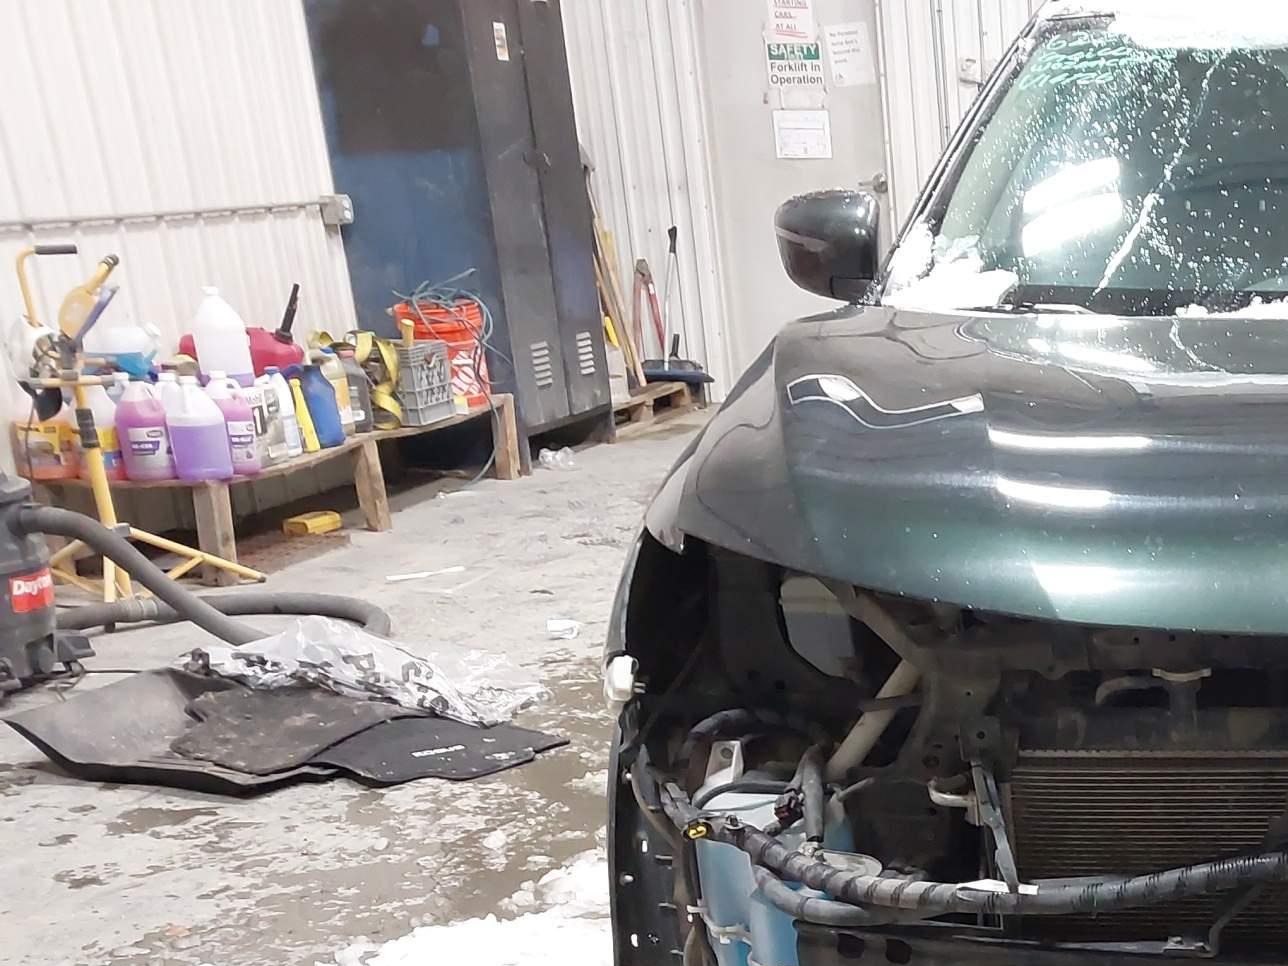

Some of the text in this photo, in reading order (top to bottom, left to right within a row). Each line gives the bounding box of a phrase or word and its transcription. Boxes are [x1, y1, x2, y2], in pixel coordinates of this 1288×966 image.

[769, 44, 817, 56] SAFETY
[770, 62, 808, 72] Forklift
[770, 74, 823, 86] Operation
